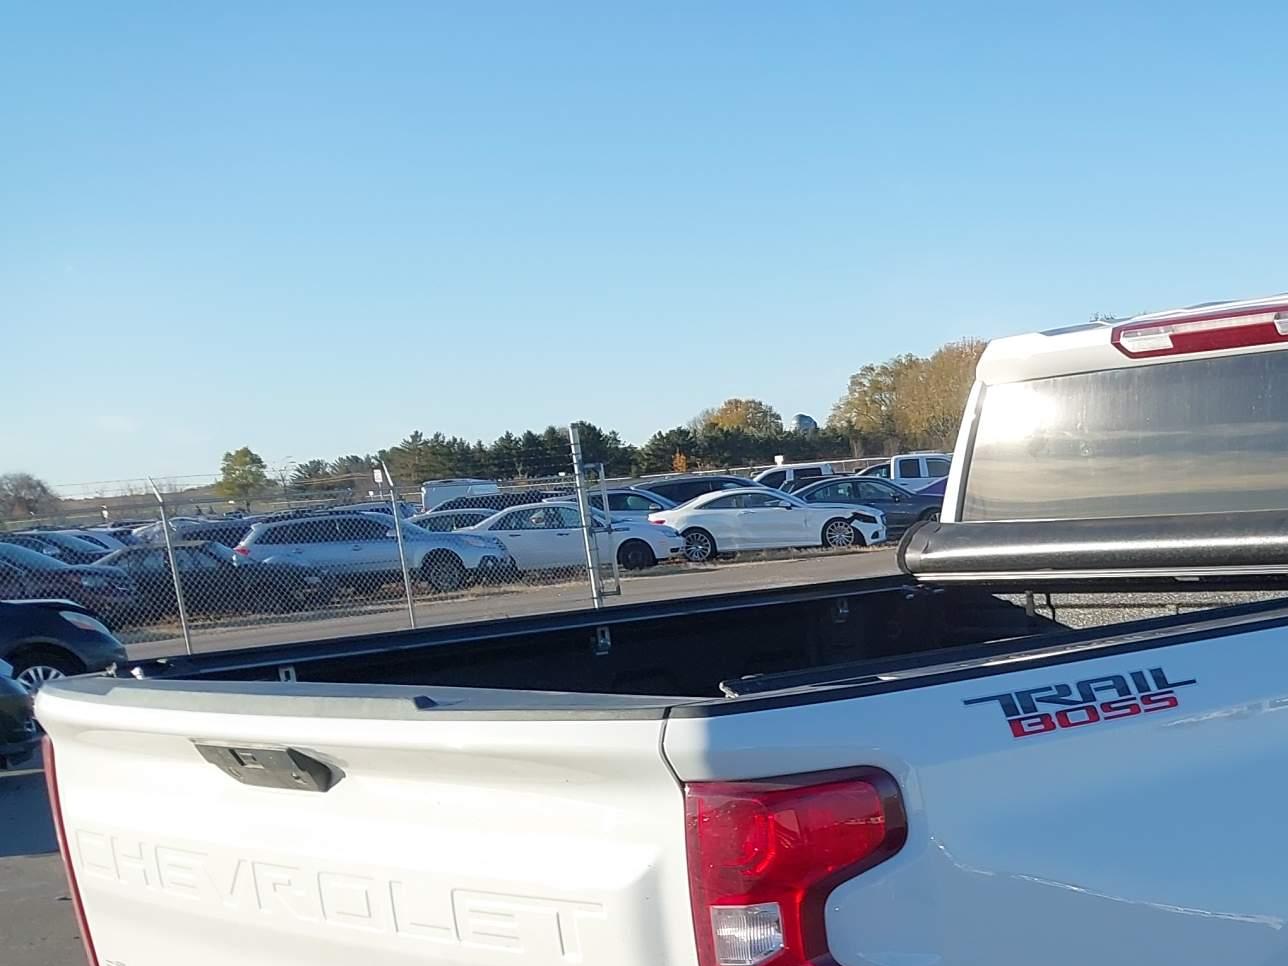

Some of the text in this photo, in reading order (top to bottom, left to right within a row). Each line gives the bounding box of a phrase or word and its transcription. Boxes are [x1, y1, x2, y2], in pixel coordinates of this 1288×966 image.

[963, 667, 1197, 718] TRAIL
[1007, 690, 1179, 738] BOSS
[73, 827, 606, 962] CHEVROLET
